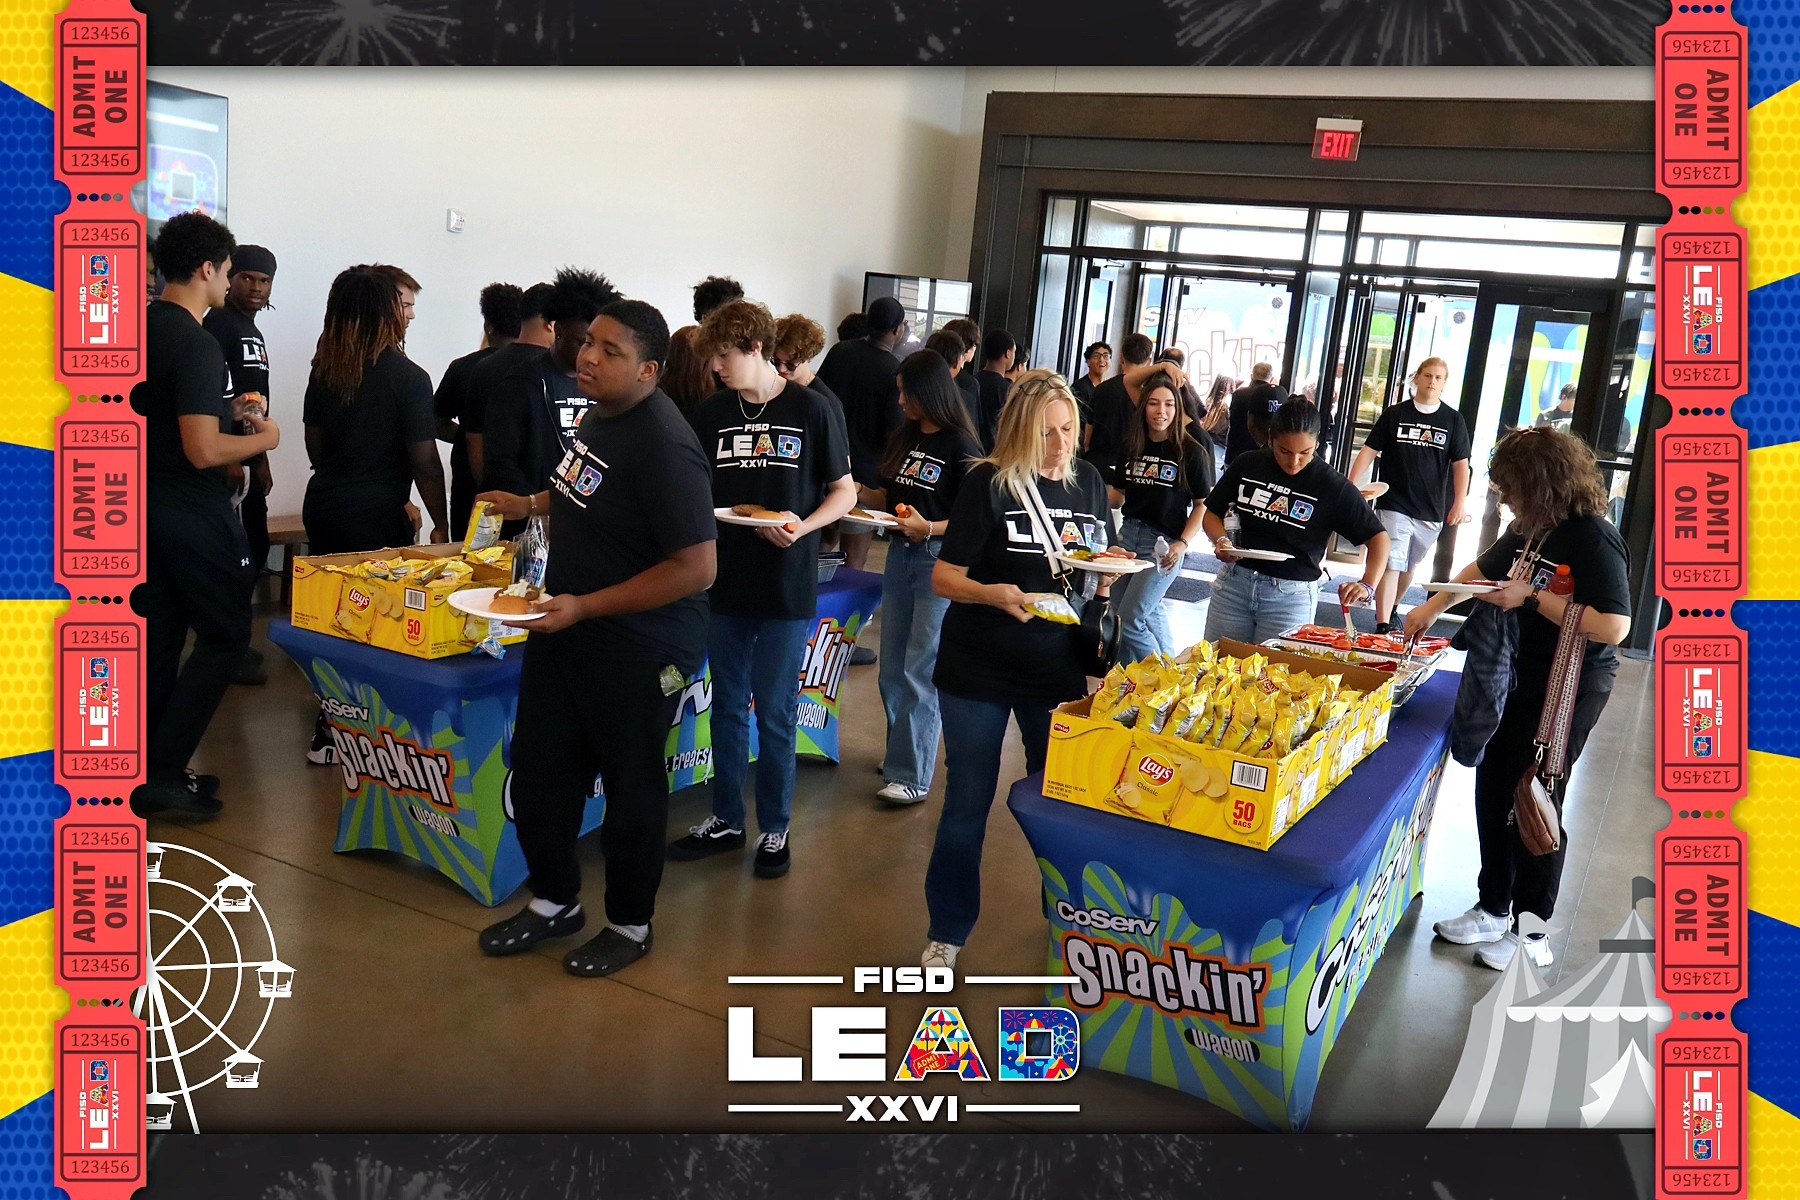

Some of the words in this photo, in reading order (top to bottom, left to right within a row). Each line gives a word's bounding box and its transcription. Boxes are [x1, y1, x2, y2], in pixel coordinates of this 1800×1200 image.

[1320, 132, 1355, 158] EXIT
[744, 423, 770, 432] FISD
[1396, 426, 1447, 445] LEAD
[716, 433, 802, 460] LEAD
[740, 459, 767, 468] XXVI
[1142, 455, 1160, 463] FISD
[556, 448, 602, 496] EAD
[1267, 482, 1291, 495] FISD
[1237, 484, 1314, 522] LEAD
[1253, 509, 1280, 523] XXVI
[407, 619, 421, 635] 50
[1139, 757, 1173, 780] Lay's
[1137, 781, 1159, 798] Classic
[1232, 799, 1256, 822] 50
[412, 805, 458, 838] wagon
[1232, 819, 1252, 829] BAGS
[1057, 901, 1158, 934] CoServ
[1191, 1029, 1255, 1063] wagon
